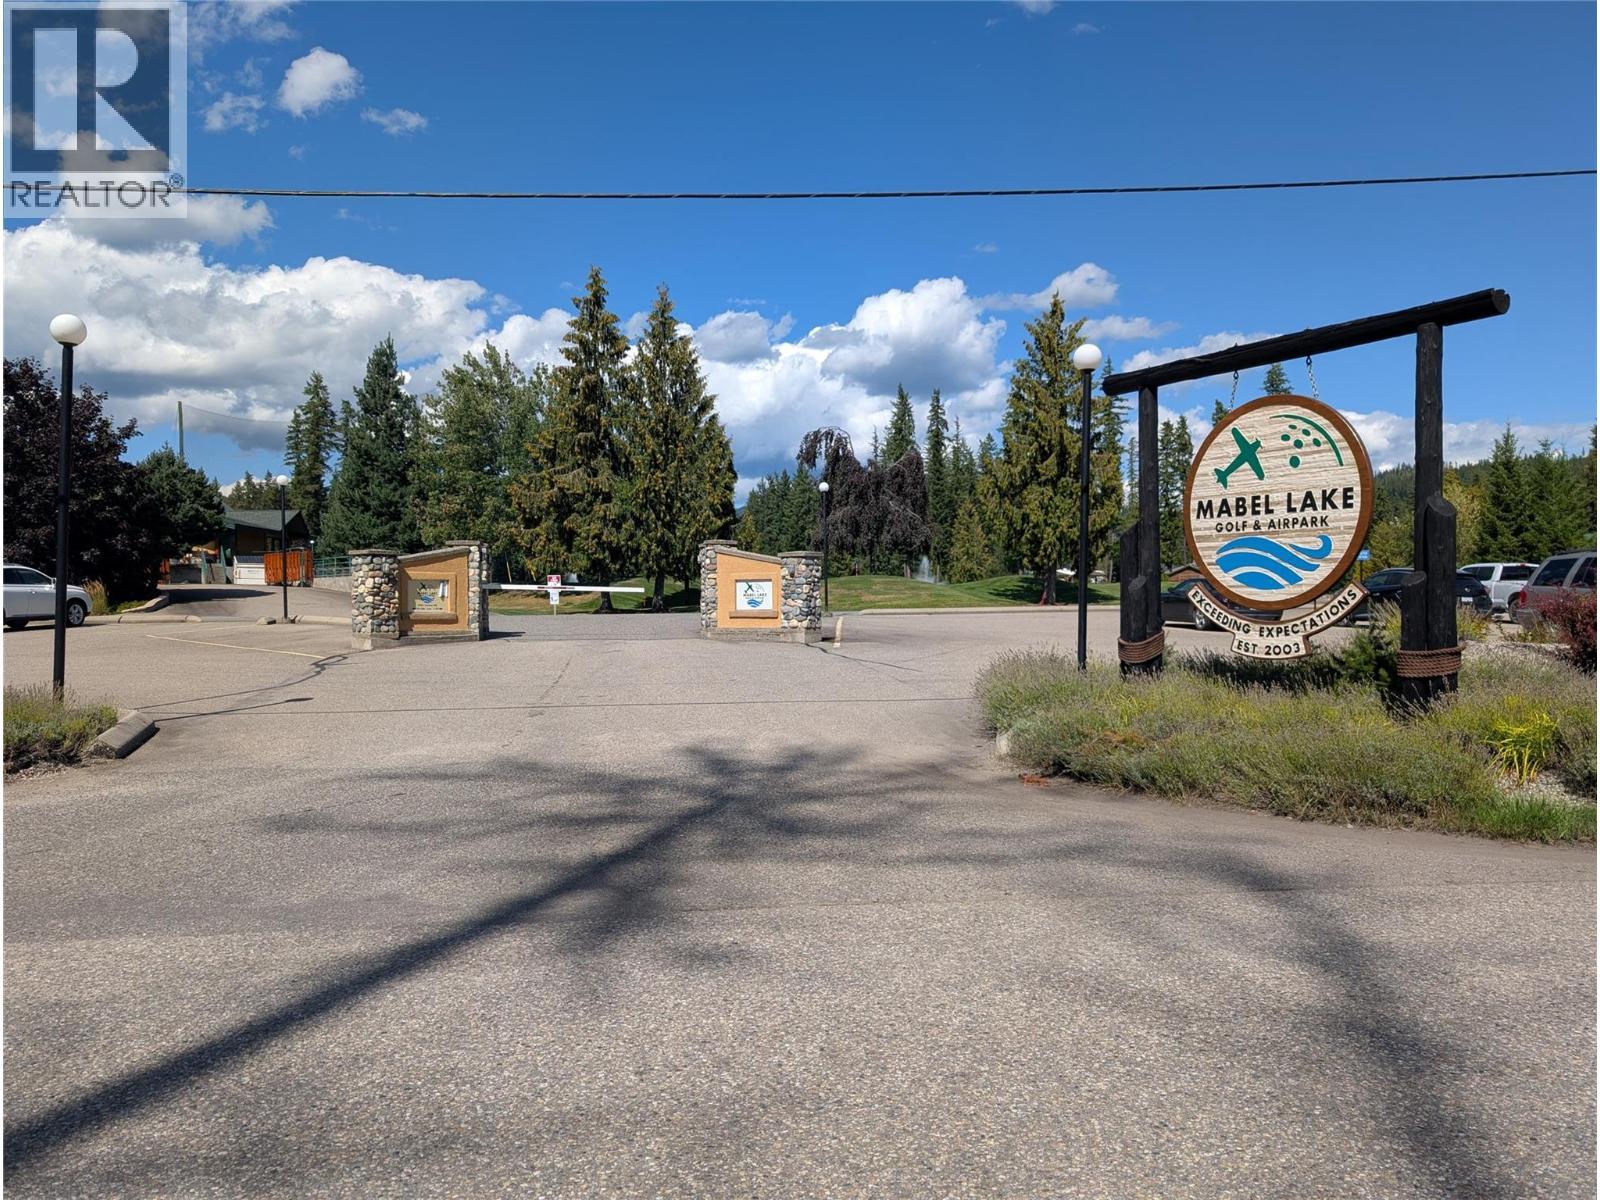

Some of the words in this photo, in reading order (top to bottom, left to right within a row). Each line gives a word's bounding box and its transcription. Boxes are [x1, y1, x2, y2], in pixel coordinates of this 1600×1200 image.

[1196, 494, 1274, 520] MABEL
[1286, 487, 1354, 513] LAKE
[1215, 520, 1248, 533] GOLF
[1253, 519, 1262, 531] &
[1267, 515, 1330, 530] AIRPARK
[1191, 590, 1251, 634] EXCEEDING
[1258, 589, 1357, 638] EXPECTATIONS
[1264, 642, 1301, 656] 2003
